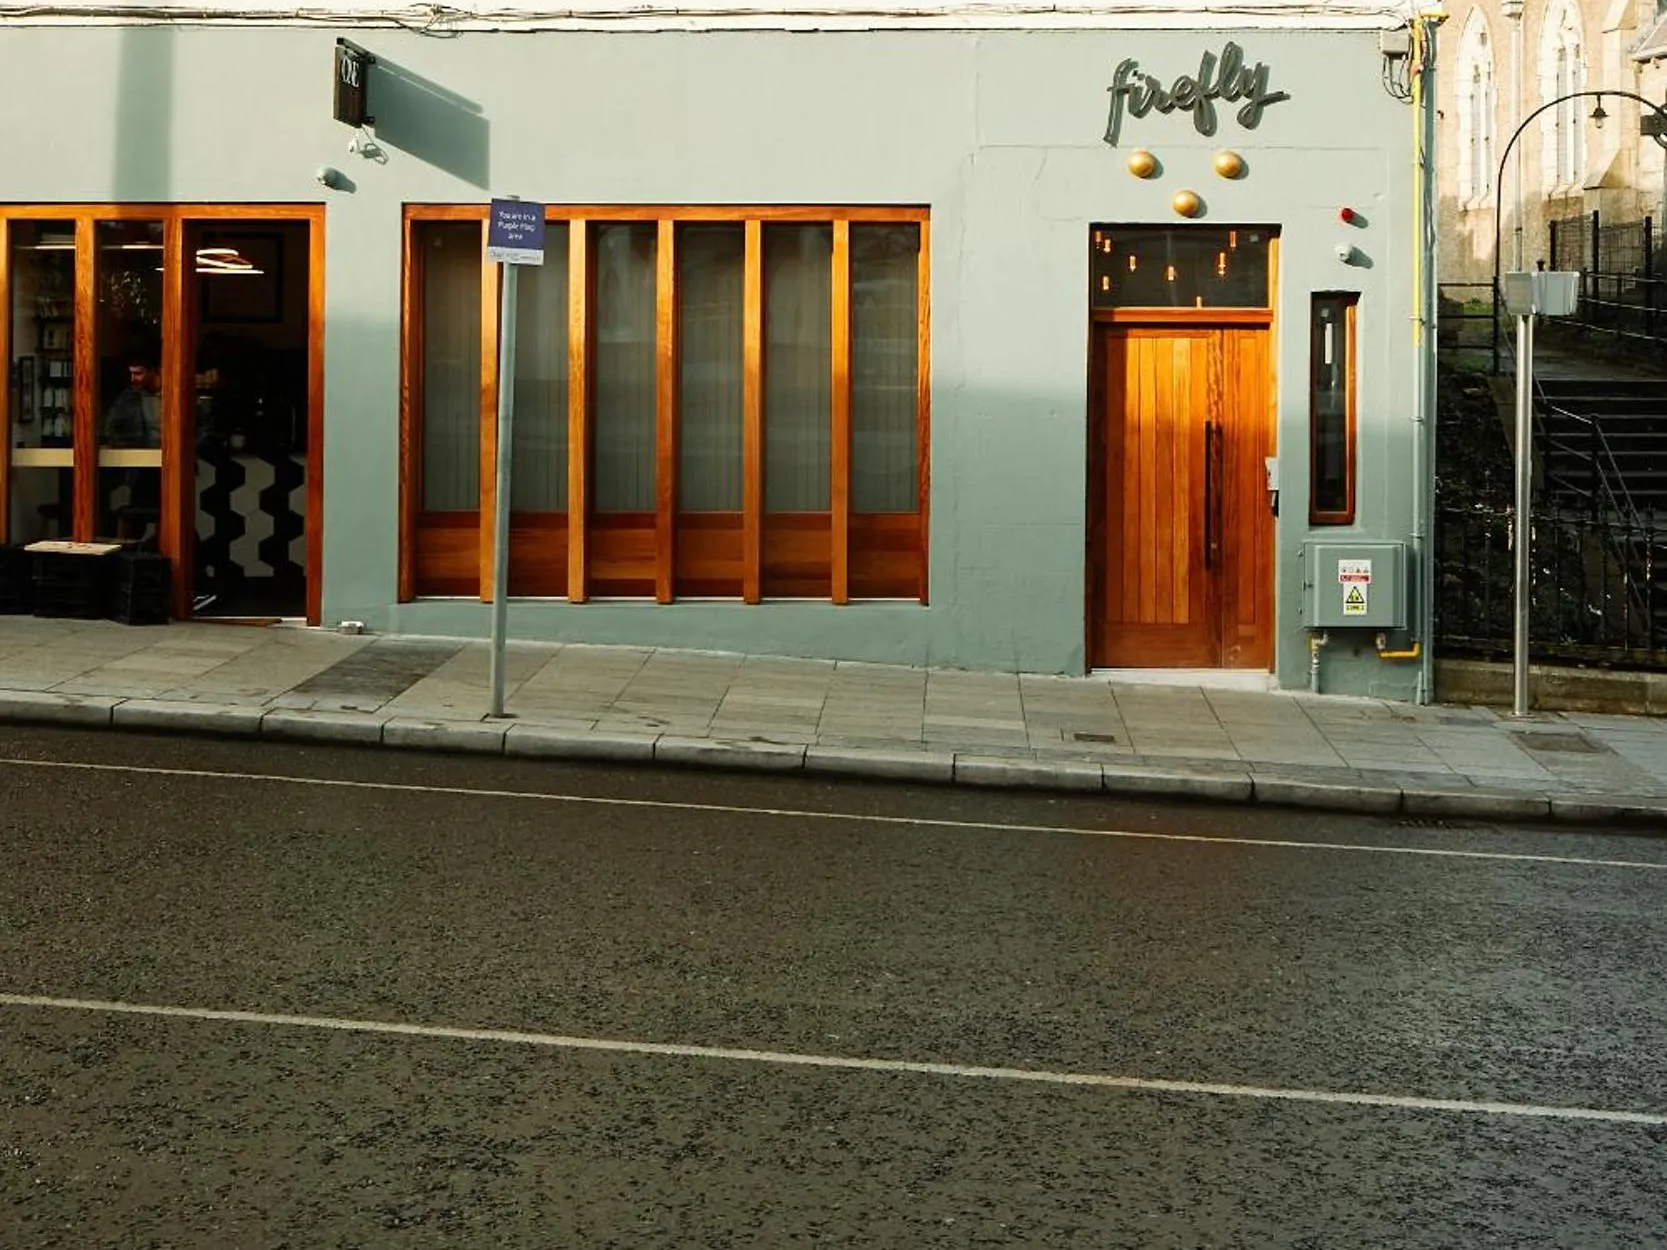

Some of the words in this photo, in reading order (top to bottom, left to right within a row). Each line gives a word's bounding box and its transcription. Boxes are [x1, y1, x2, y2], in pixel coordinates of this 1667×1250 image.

[1102, 40, 1292, 148] firefly
[499, 211, 511, 219] You
[498, 221, 519, 230] Purple
[520, 223, 536, 232] Flag
